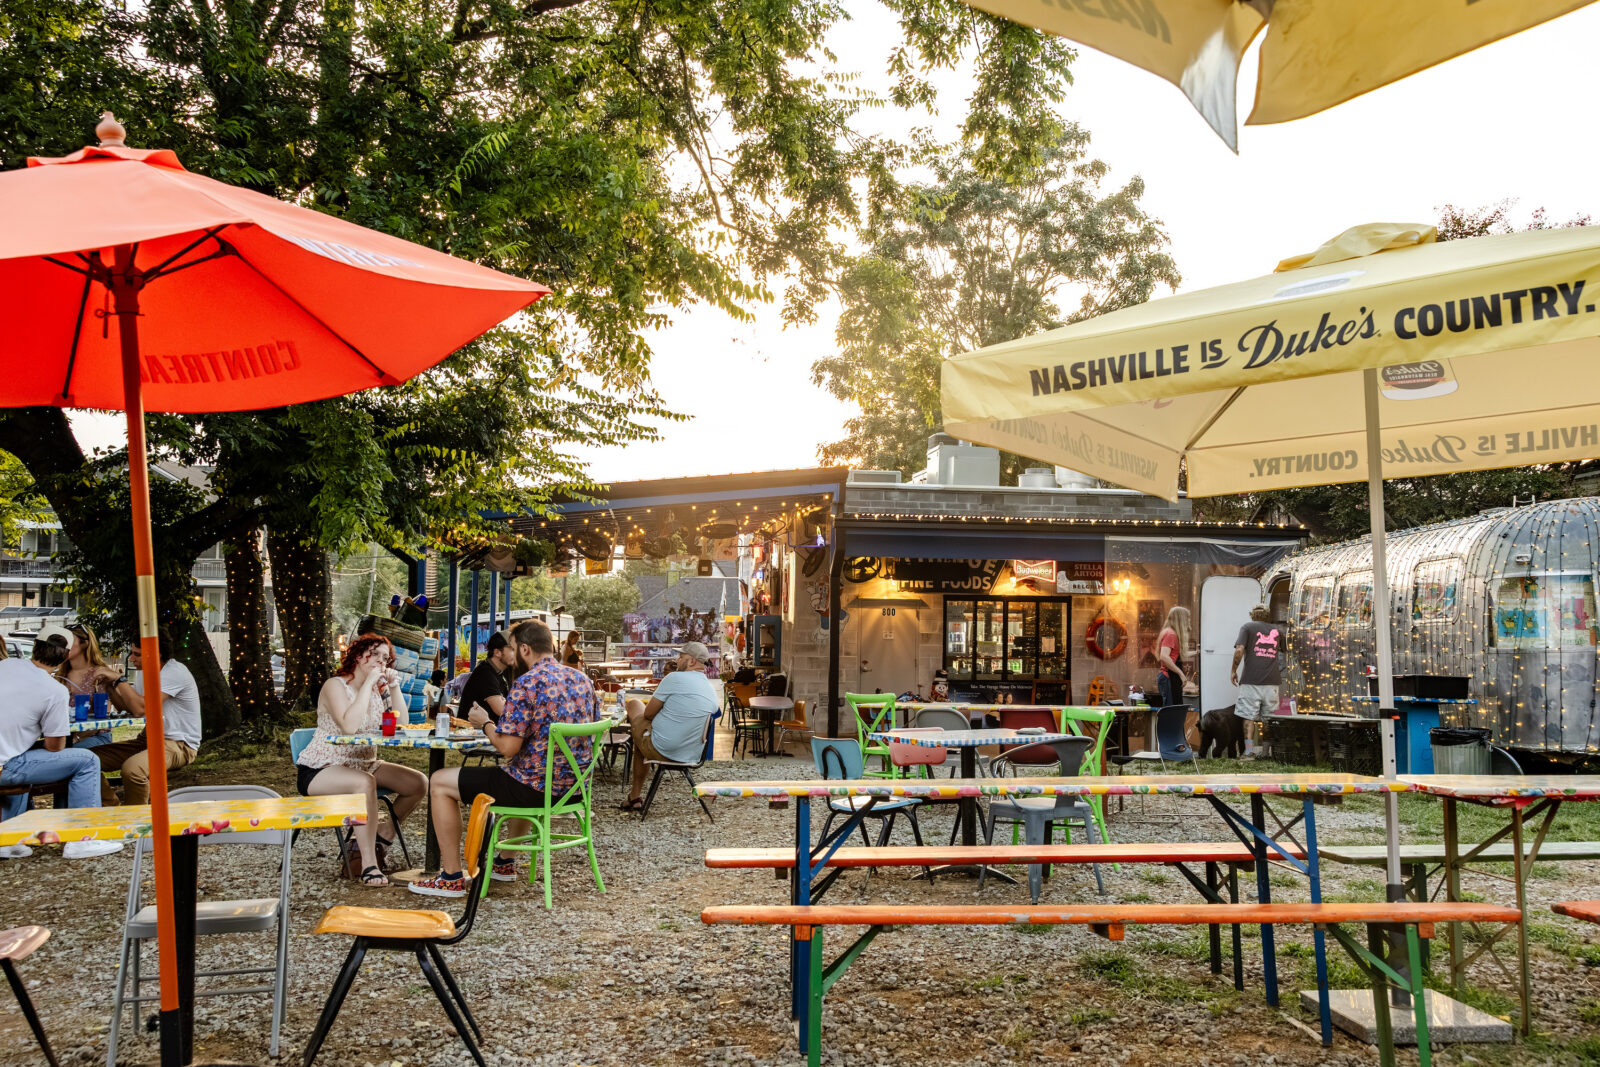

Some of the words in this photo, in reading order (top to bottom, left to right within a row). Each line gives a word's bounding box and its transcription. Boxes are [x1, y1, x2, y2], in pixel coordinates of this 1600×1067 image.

[1029, 344, 1190, 396] NASHVILLE
[1200, 339, 1229, 367] IS
[1237, 306, 1380, 369] Duke's
[1394, 280, 1596, 340] COUNTRY.
[1016, 564, 1053, 577] Budweiser
[1074, 563, 1103, 571] STELLA
[1074, 570, 1103, 578] ARTOIS
[941, 575, 992, 590] FOODS
[881, 607, 896, 617] 800
